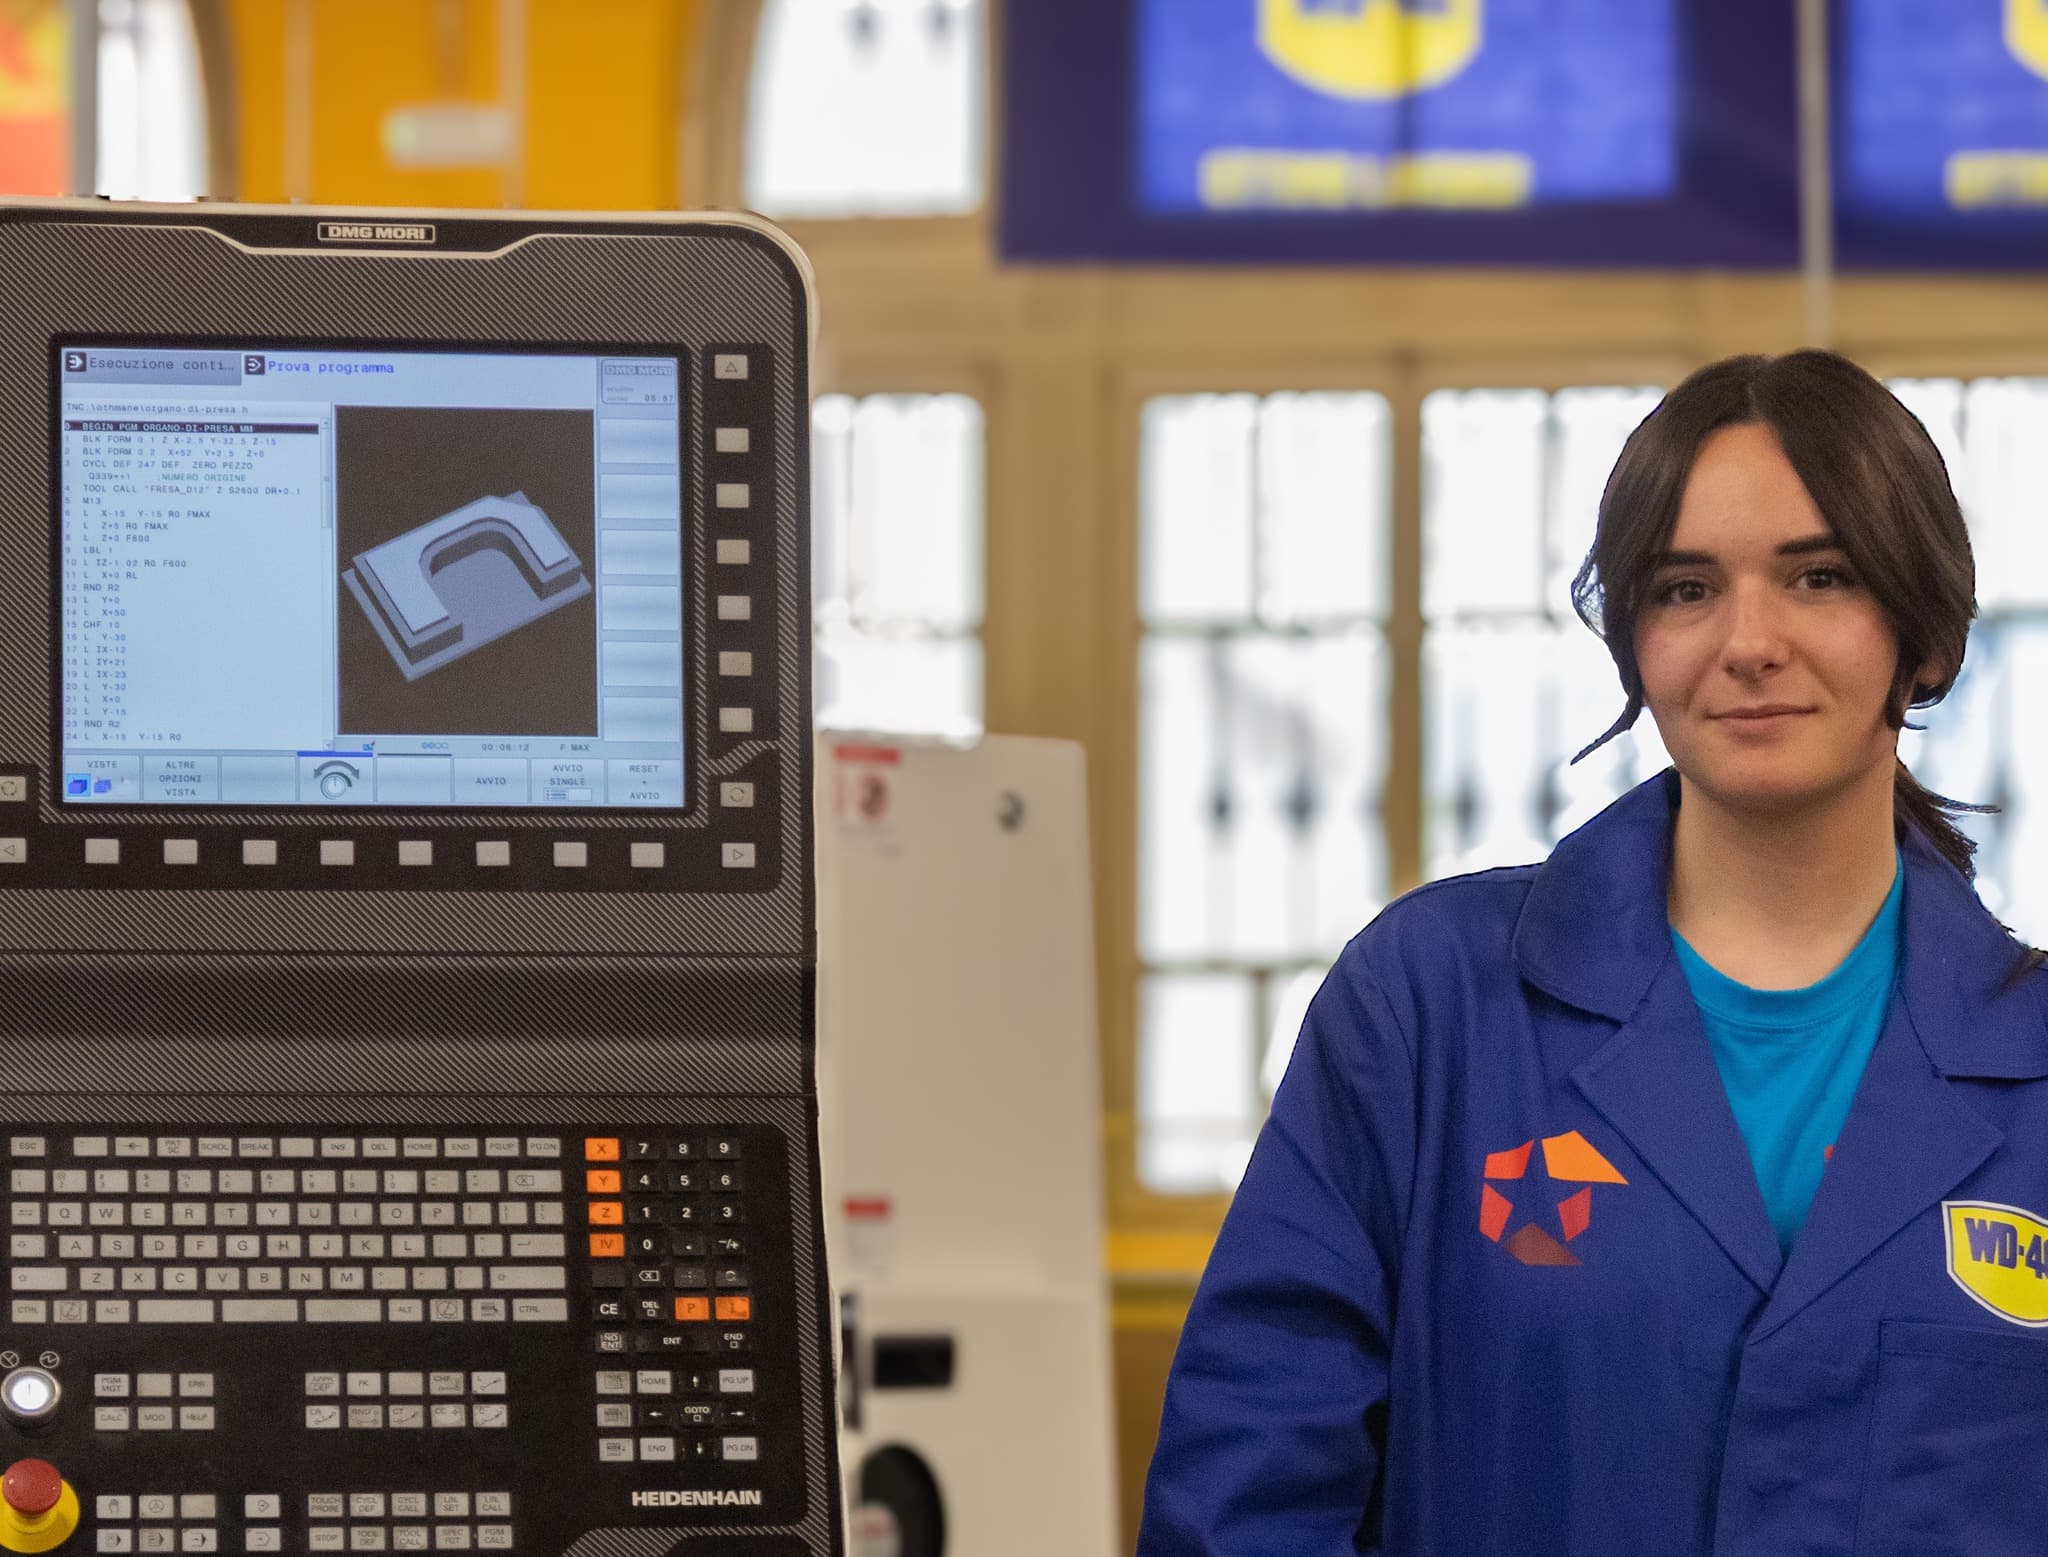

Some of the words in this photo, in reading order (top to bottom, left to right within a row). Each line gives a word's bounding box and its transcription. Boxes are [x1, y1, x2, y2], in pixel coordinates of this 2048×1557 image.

[328, 226, 371, 239] DMG
[375, 226, 426, 240] MORI
[89, 358, 174, 370] Esecuzione
[268, 361, 310, 372] Prova
[318, 362, 395, 375] programma
[82, 423, 113, 431] BEGIN
[143, 424, 234, 433] ORGANO-DI-PRESA
[239, 425, 253, 433] MM
[107, 436, 132, 444] FORM
[107, 448, 132, 456] FORM
[223, 462, 253, 470] PEZZO
[204, 474, 247, 482] ORIGINE
[571, 744, 590, 752] MAX
[87, 761, 117, 769] VISTE
[166, 761, 195, 769] ALTRE
[629, 765, 659, 773] RESET
[159, 775, 201, 783] OPZIONI
[550, 778, 585, 786] SINGLE
[629, 792, 660, 800] AVVIO
[597, 1144, 606, 1153] X
[639, 1143, 648, 1154] 7
[679, 1143, 687, 1153] 8
[720, 1143, 728, 1153] 9
[600, 1176, 607, 1184] Y
[640, 1175, 649, 1185] 4
[680, 1175, 689, 1185] 5
[721, 1175, 730, 1185] 6
[59, 1208, 70, 1218] Q
[99, 1208, 113, 1218] W
[144, 1208, 151, 1218] E
[185, 1209, 193, 1218] R
[227, 1208, 235, 1218] T
[268, 1208, 277, 1218] Y
[309, 1208, 320, 1218] U
[392, 1208, 402, 1219] O
[433, 1208, 441, 1217] P
[602, 1208, 610, 1217] Z
[643, 1208, 650, 1217] 1
[682, 1208, 691, 1218] 2
[723, 1207, 732, 1217] 3
[71, 1241, 81, 1250] A
[113, 1241, 122, 1251] S
[155, 1241, 164, 1251] D
[197, 1241, 204, 1250] F
[237, 1241, 248, 1251] G
[279, 1241, 289, 1250] H
[323, 1241, 330, 1250] J
[361, 1241, 370, 1250] K
[404, 1241, 412, 1251] L
[643, 1239, 652, 1250] 0
[92, 1273, 101, 1283] Z
[133, 1273, 143, 1283] X
[176, 1273, 185, 1283] C
[218, 1273, 228, 1283] V
[260, 1273, 269, 1283] B
[301, 1273, 310, 1283] N
[341, 1273, 353, 1283] M
[600, 1304, 618, 1314] CE
[688, 1304, 696, 1313] P
[632, 1490, 762, 1506] HEIDENHAIN
